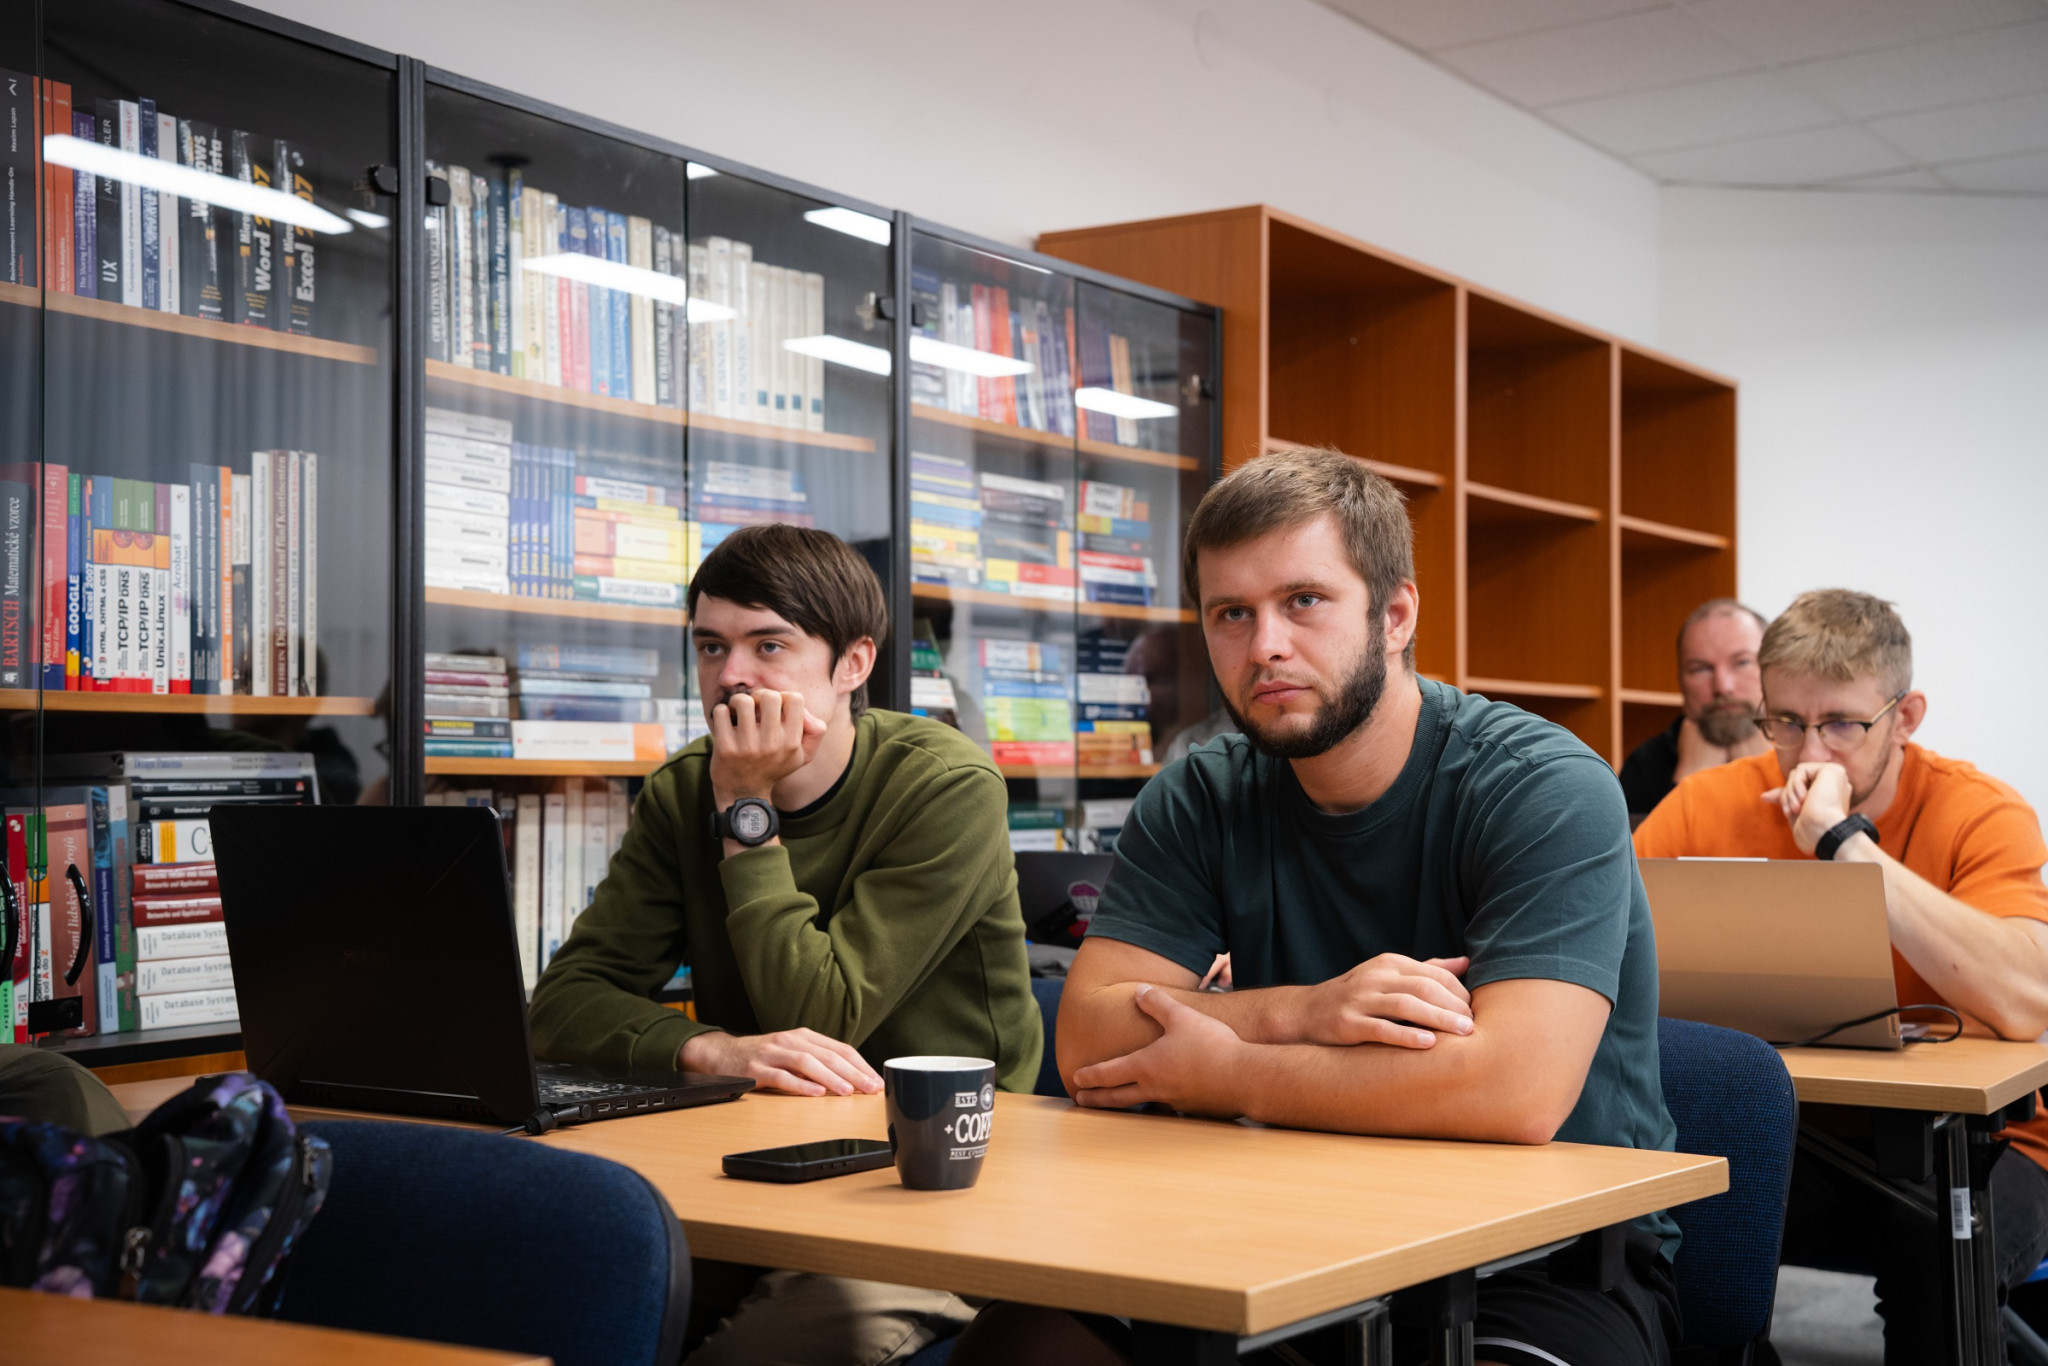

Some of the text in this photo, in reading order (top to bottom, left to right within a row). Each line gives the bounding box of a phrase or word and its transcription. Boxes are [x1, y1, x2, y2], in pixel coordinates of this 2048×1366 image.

[10, 107, 18, 128] Lapan
[208, 139, 224, 173] ista
[190, 135, 208, 218] Wows
[9, 201, 17, 231] Learning
[9, 231, 17, 281] Reinforcement
[102, 259, 118, 283] UX
[253, 230, 272, 292] Word
[294, 242, 315, 303] Excel
[3, 497, 20, 667] BARTSCH Matematické vzorce
[173, 545, 182, 589] Acrobat
[84, 562, 94, 620] Excel 2007
[121, 570, 130, 597] DNS
[142, 572, 150, 599] DNS
[69, 574, 80, 635] GOOGLE
[156, 594, 165, 631] Linux
[118, 599, 129, 651] TCP/IP
[138, 600, 149, 651] TCP/IP
[156, 639, 165, 669] Unix
[41, 948, 49, 957] Z
[161, 931, 202, 942] Database
[41, 958, 49, 971] do
[161, 964, 202, 977] Database
[164, 998, 205, 1010] Database
[955, 1095, 979, 1105] ESTD
